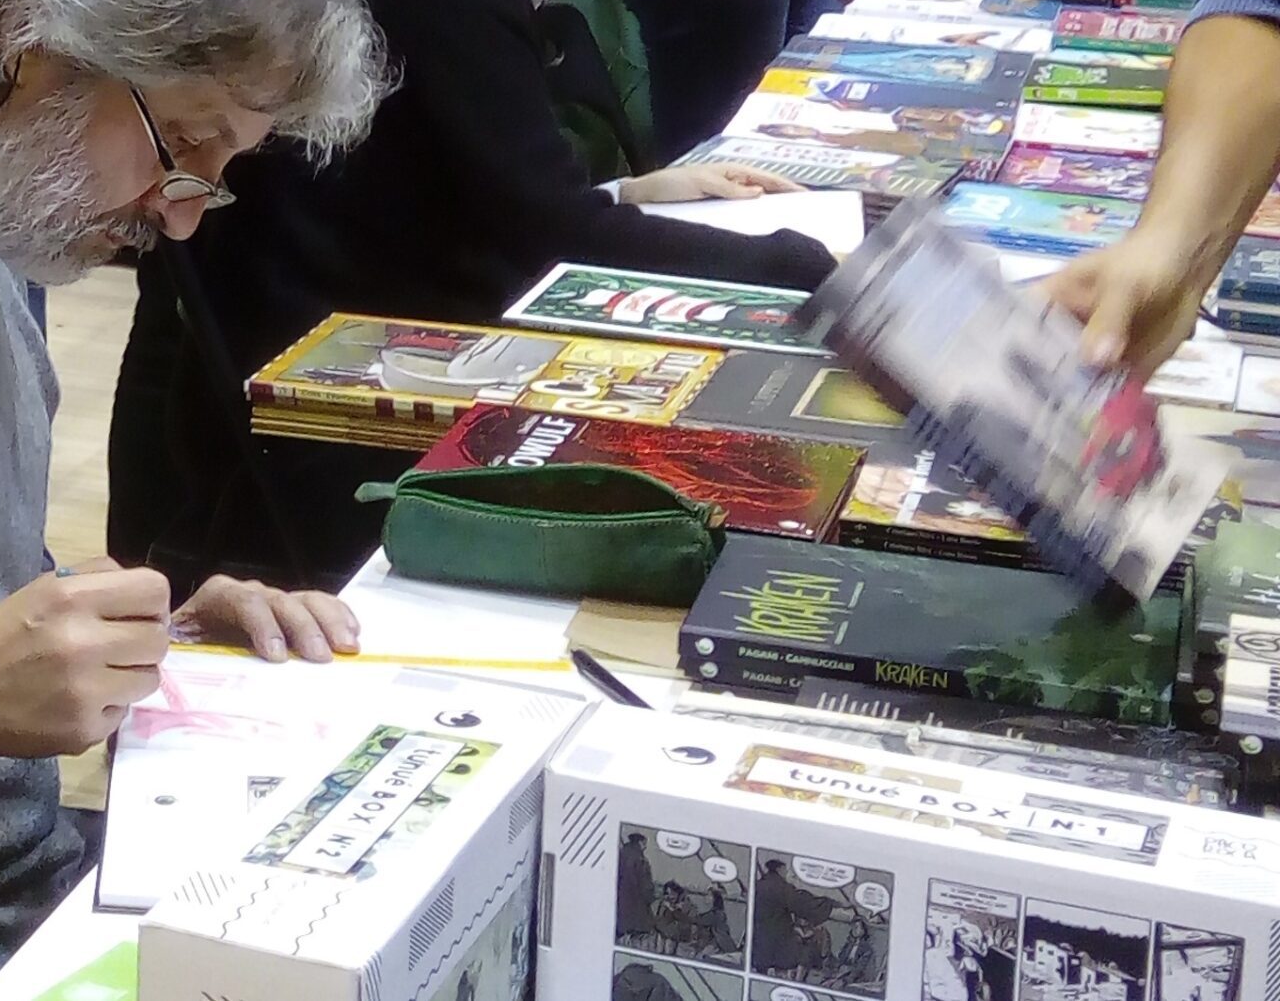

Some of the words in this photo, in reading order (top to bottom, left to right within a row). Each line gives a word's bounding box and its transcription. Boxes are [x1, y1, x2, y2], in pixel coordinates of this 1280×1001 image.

[719, 569, 854, 642] KRAKEN
[874, 659, 949, 691] KRAKEN
[347, 790, 399, 825] BOX
[789, 767, 902, 799] tunué
[919, 794, 1012, 821] BOX
